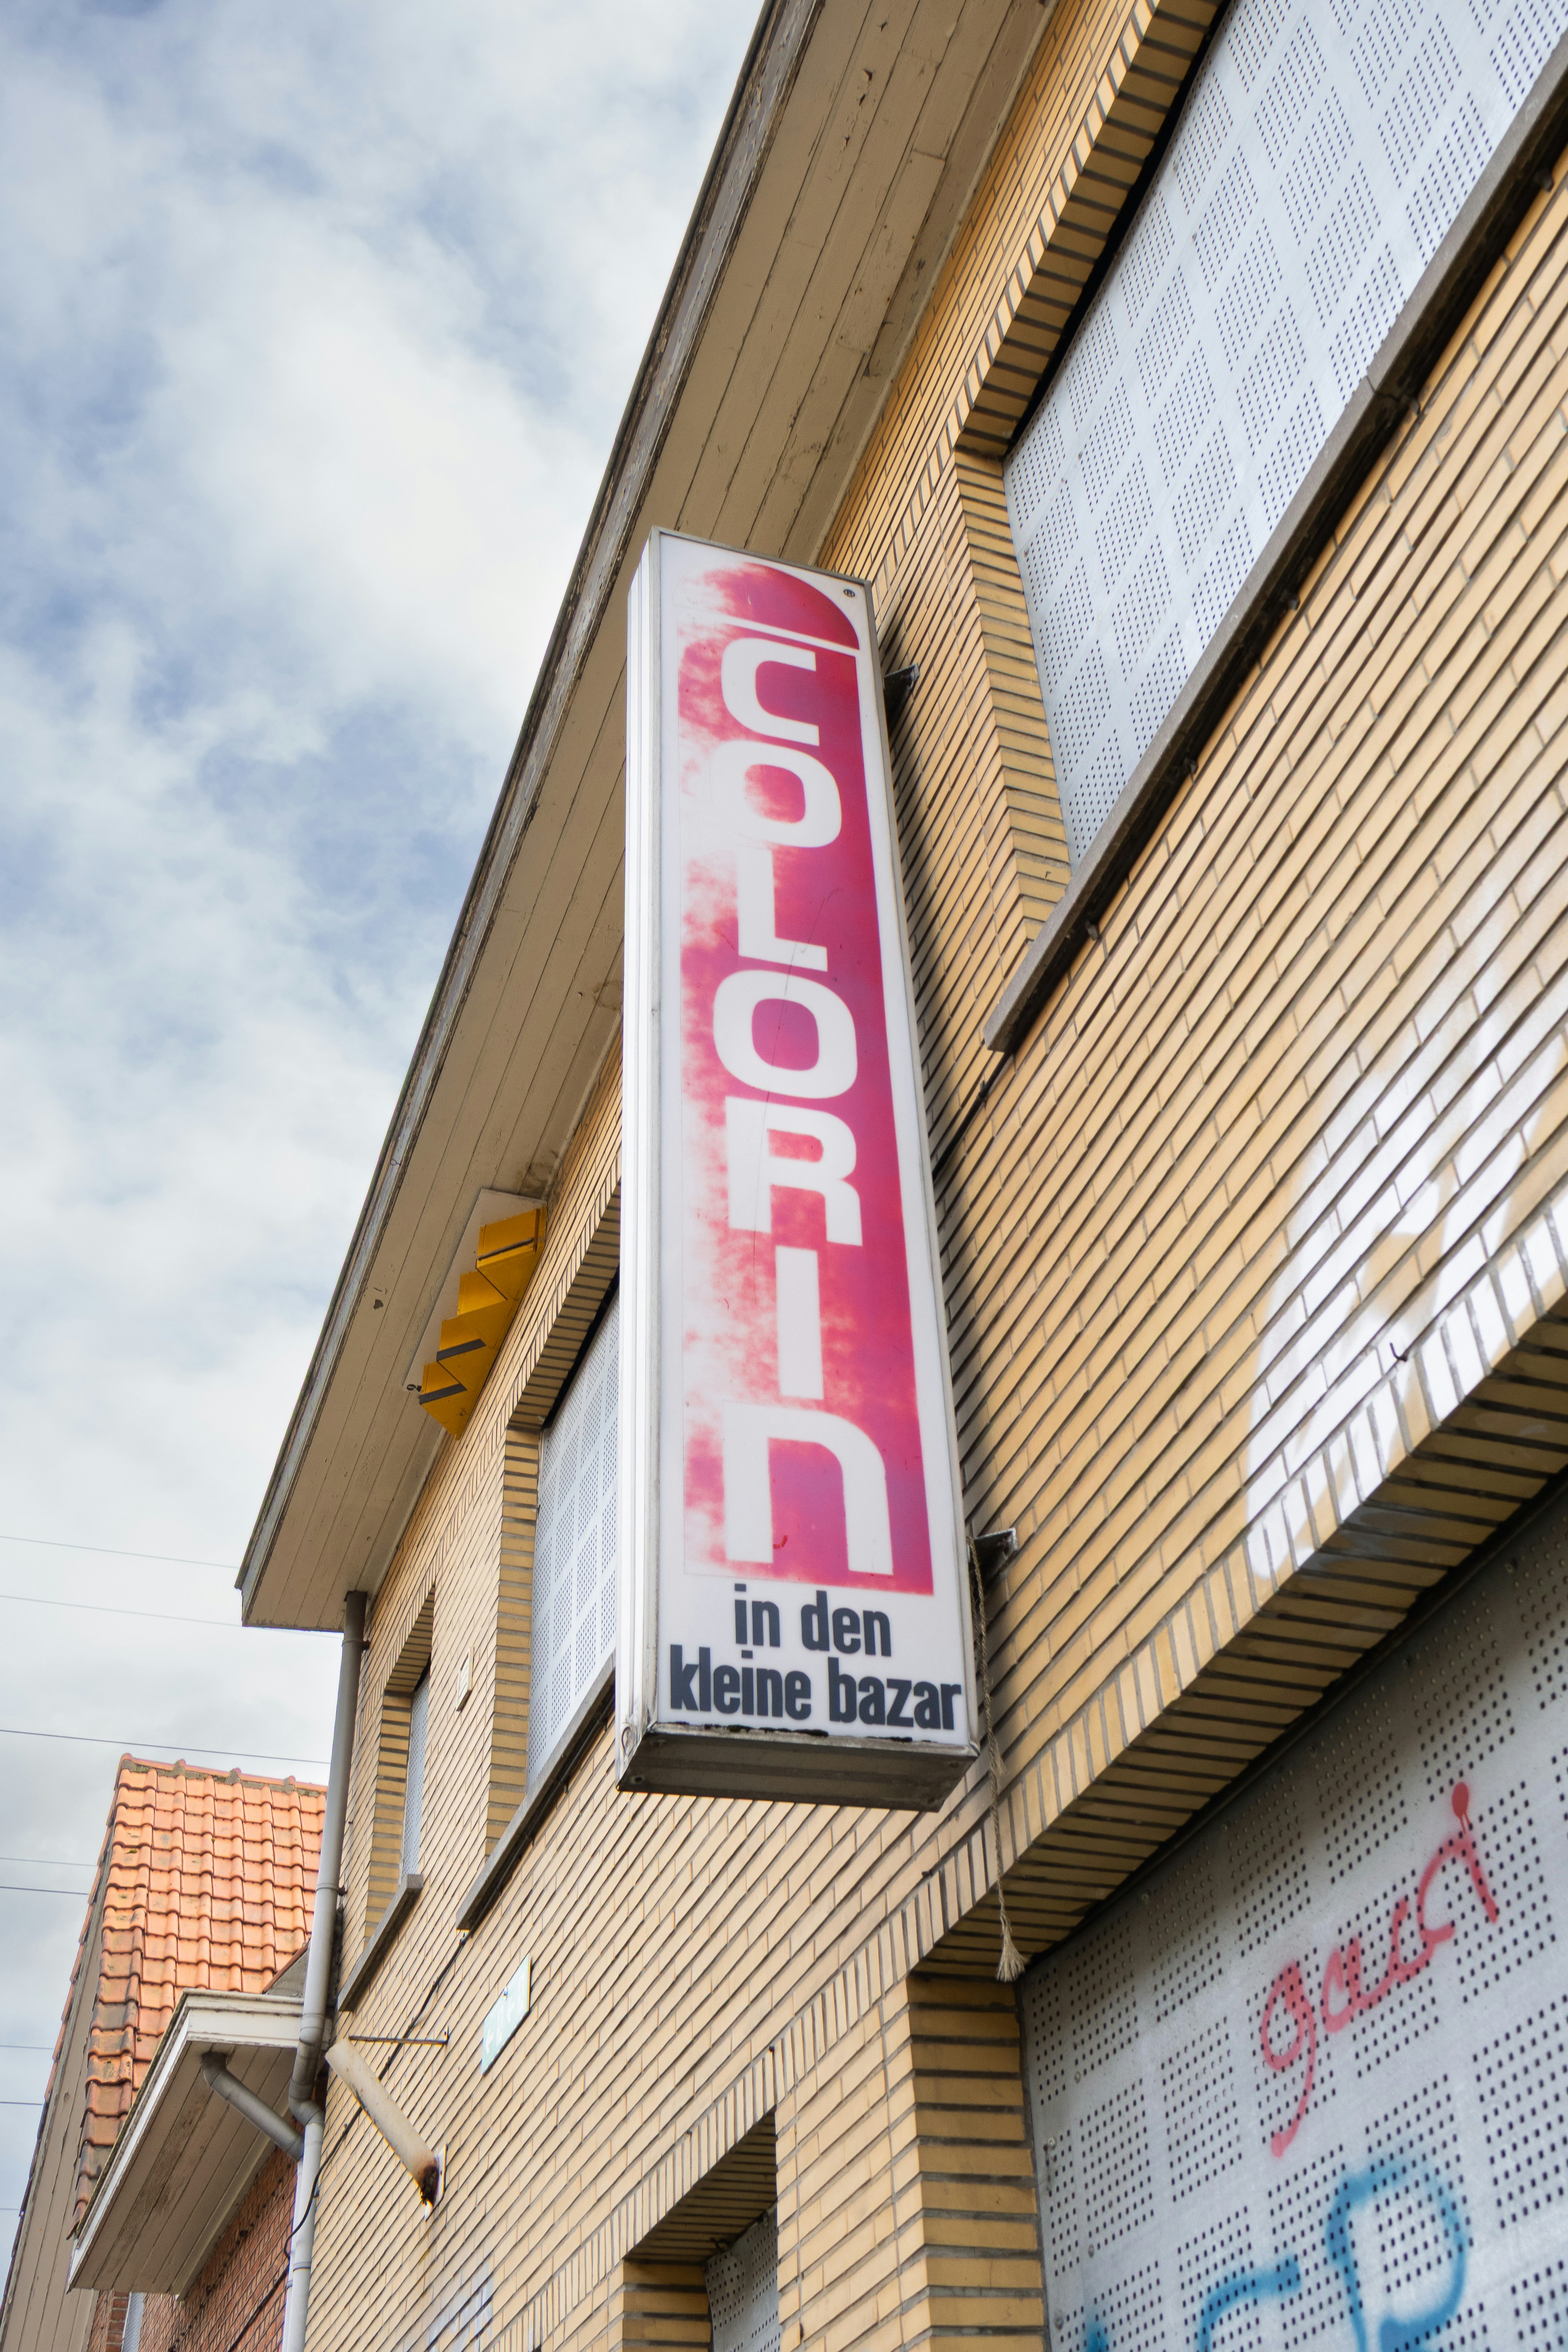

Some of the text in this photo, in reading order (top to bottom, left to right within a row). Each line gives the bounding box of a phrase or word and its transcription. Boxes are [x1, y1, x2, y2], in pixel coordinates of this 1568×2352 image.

[735, 1583, 891, 1657] in den
[669, 1644, 962, 1730] kleine bazar
